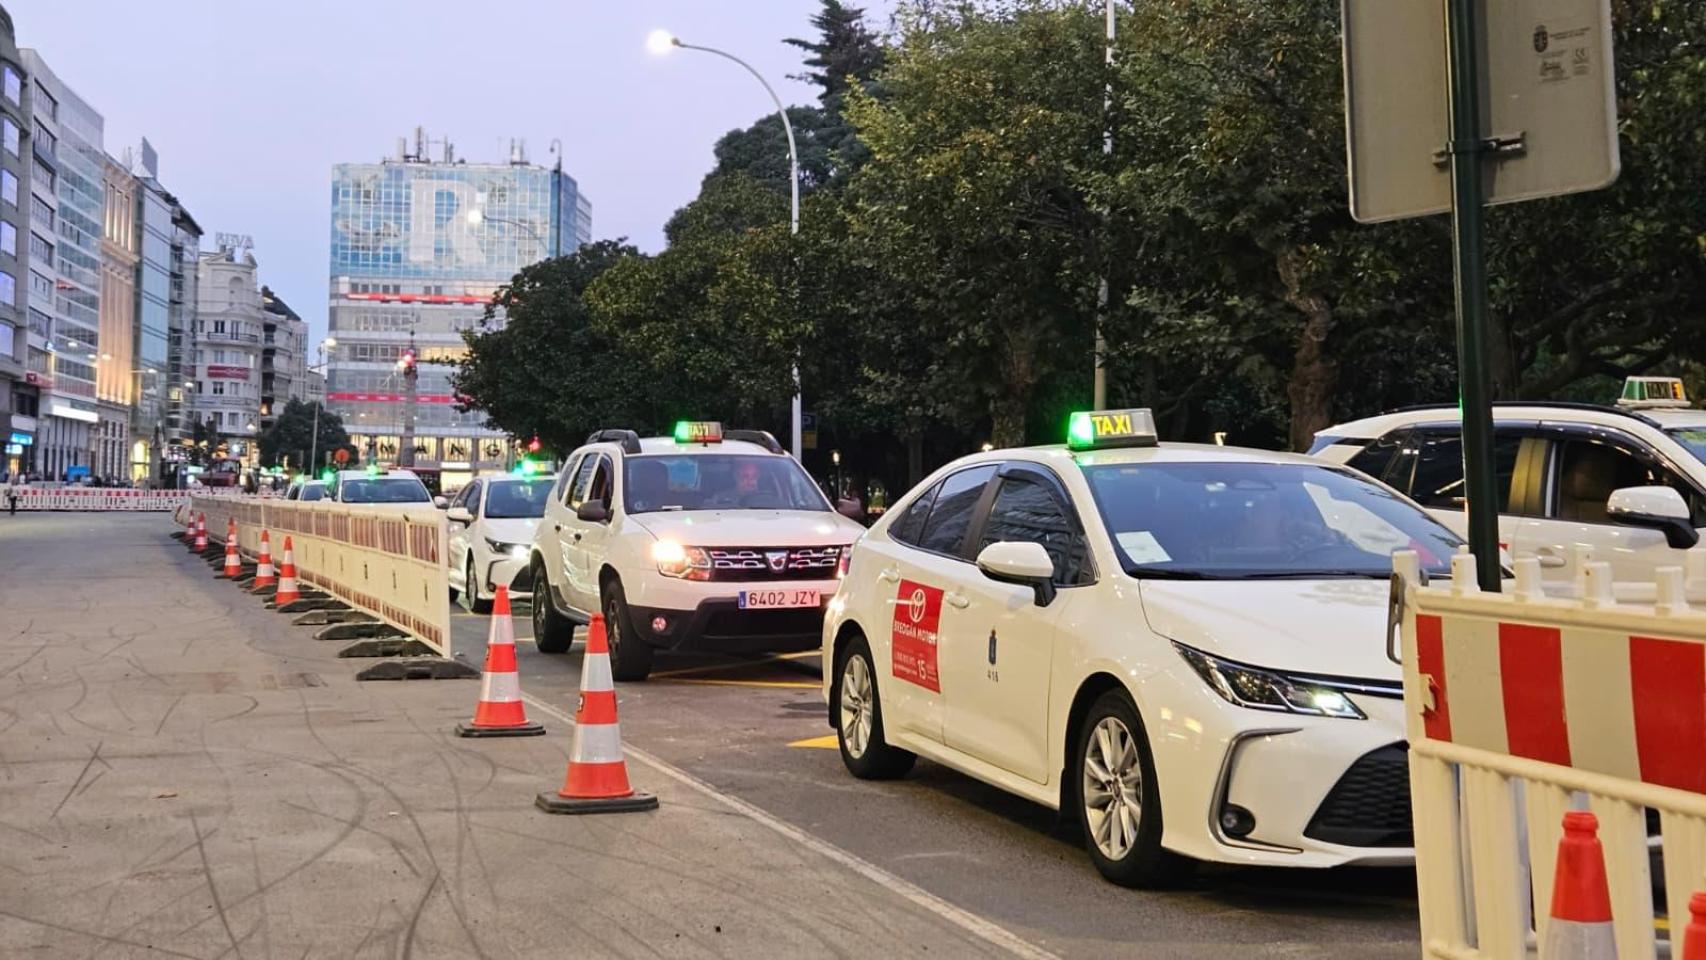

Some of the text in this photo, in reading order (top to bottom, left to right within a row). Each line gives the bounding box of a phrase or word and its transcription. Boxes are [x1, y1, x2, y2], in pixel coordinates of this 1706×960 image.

[409, 179, 486, 264] R
[1646, 382, 1670, 399] TAXI
[1091, 413, 1132, 436] TAXI
[380, 443, 500, 457] MANG
[749, 591, 816, 606] 6402 JZY
